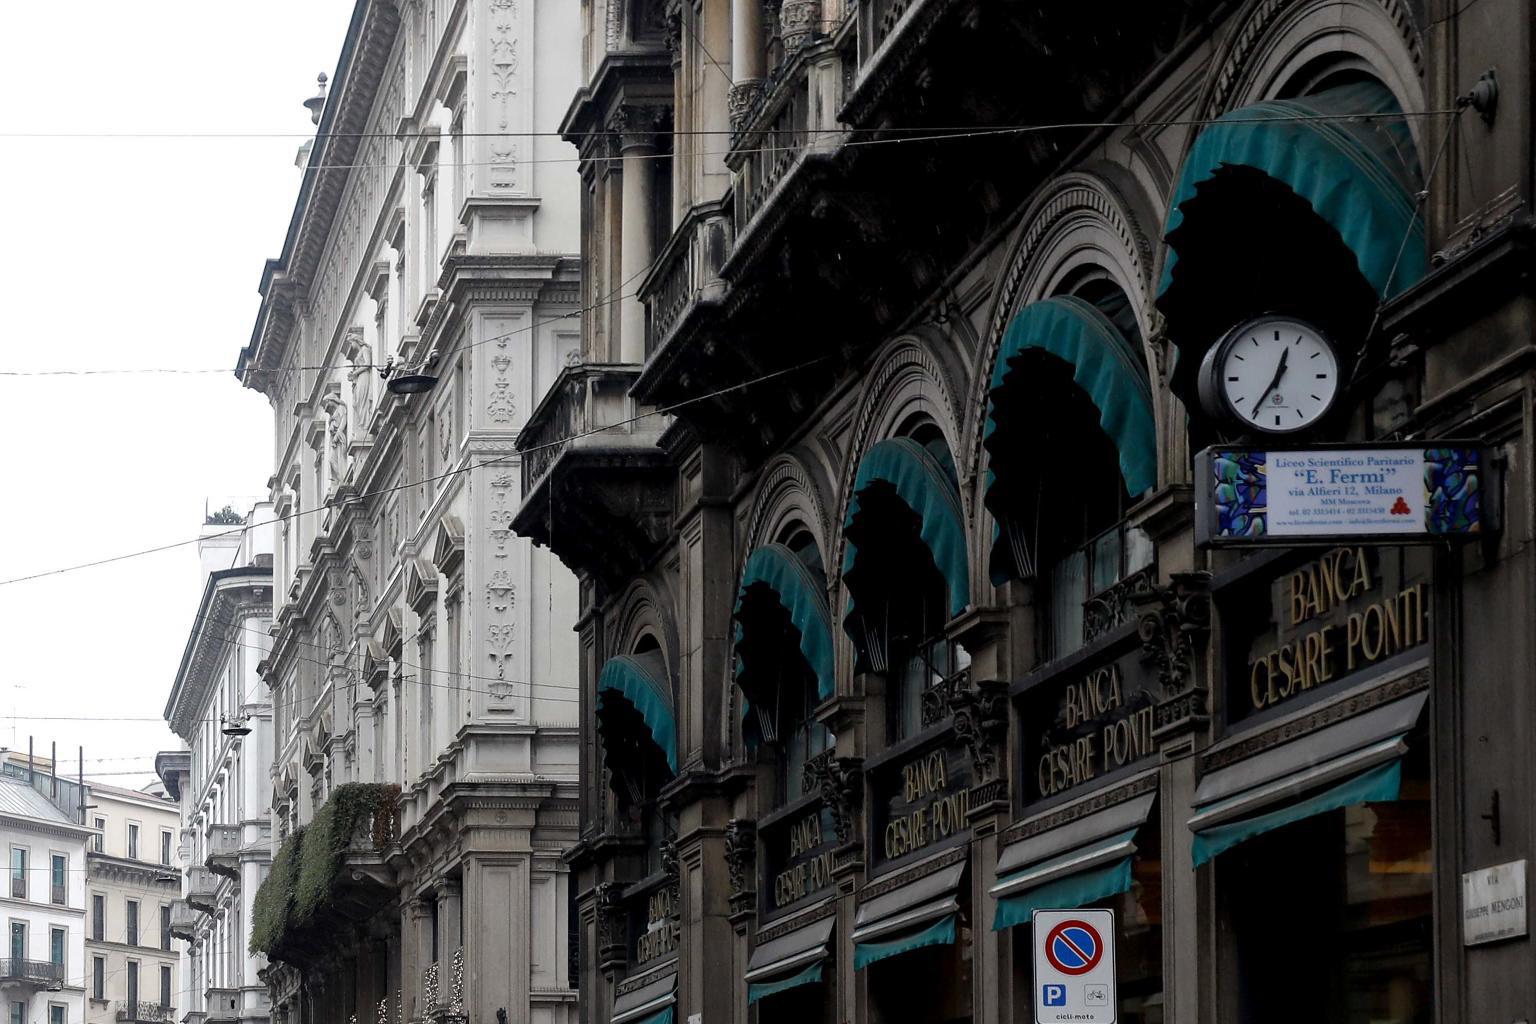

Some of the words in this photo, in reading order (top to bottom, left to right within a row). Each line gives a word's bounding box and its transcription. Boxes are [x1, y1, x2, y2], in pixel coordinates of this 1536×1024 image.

[1276, 458, 1305, 468] Liceo
[1308, 457, 1363, 467] Scientifico
[1367, 456, 1415, 467] Paritario
[1289, 488, 1305, 497] via
[1307, 486, 1341, 496] Alfieri
[1364, 485, 1403, 495] Milano
[1290, 547, 1371, 625] BANCA
[1251, 624, 1334, 710] CESARE
[1347, 583, 1425, 670] PONTI
[1066, 665, 1122, 730] BANCA
[1038, 733, 1096, 797] CESARE
[1104, 705, 1154, 772] PONTI
[906, 752, 945, 803] BANCA
[885, 808, 927, 859] CESARE
[1047, 986, 1062, 1005] P
